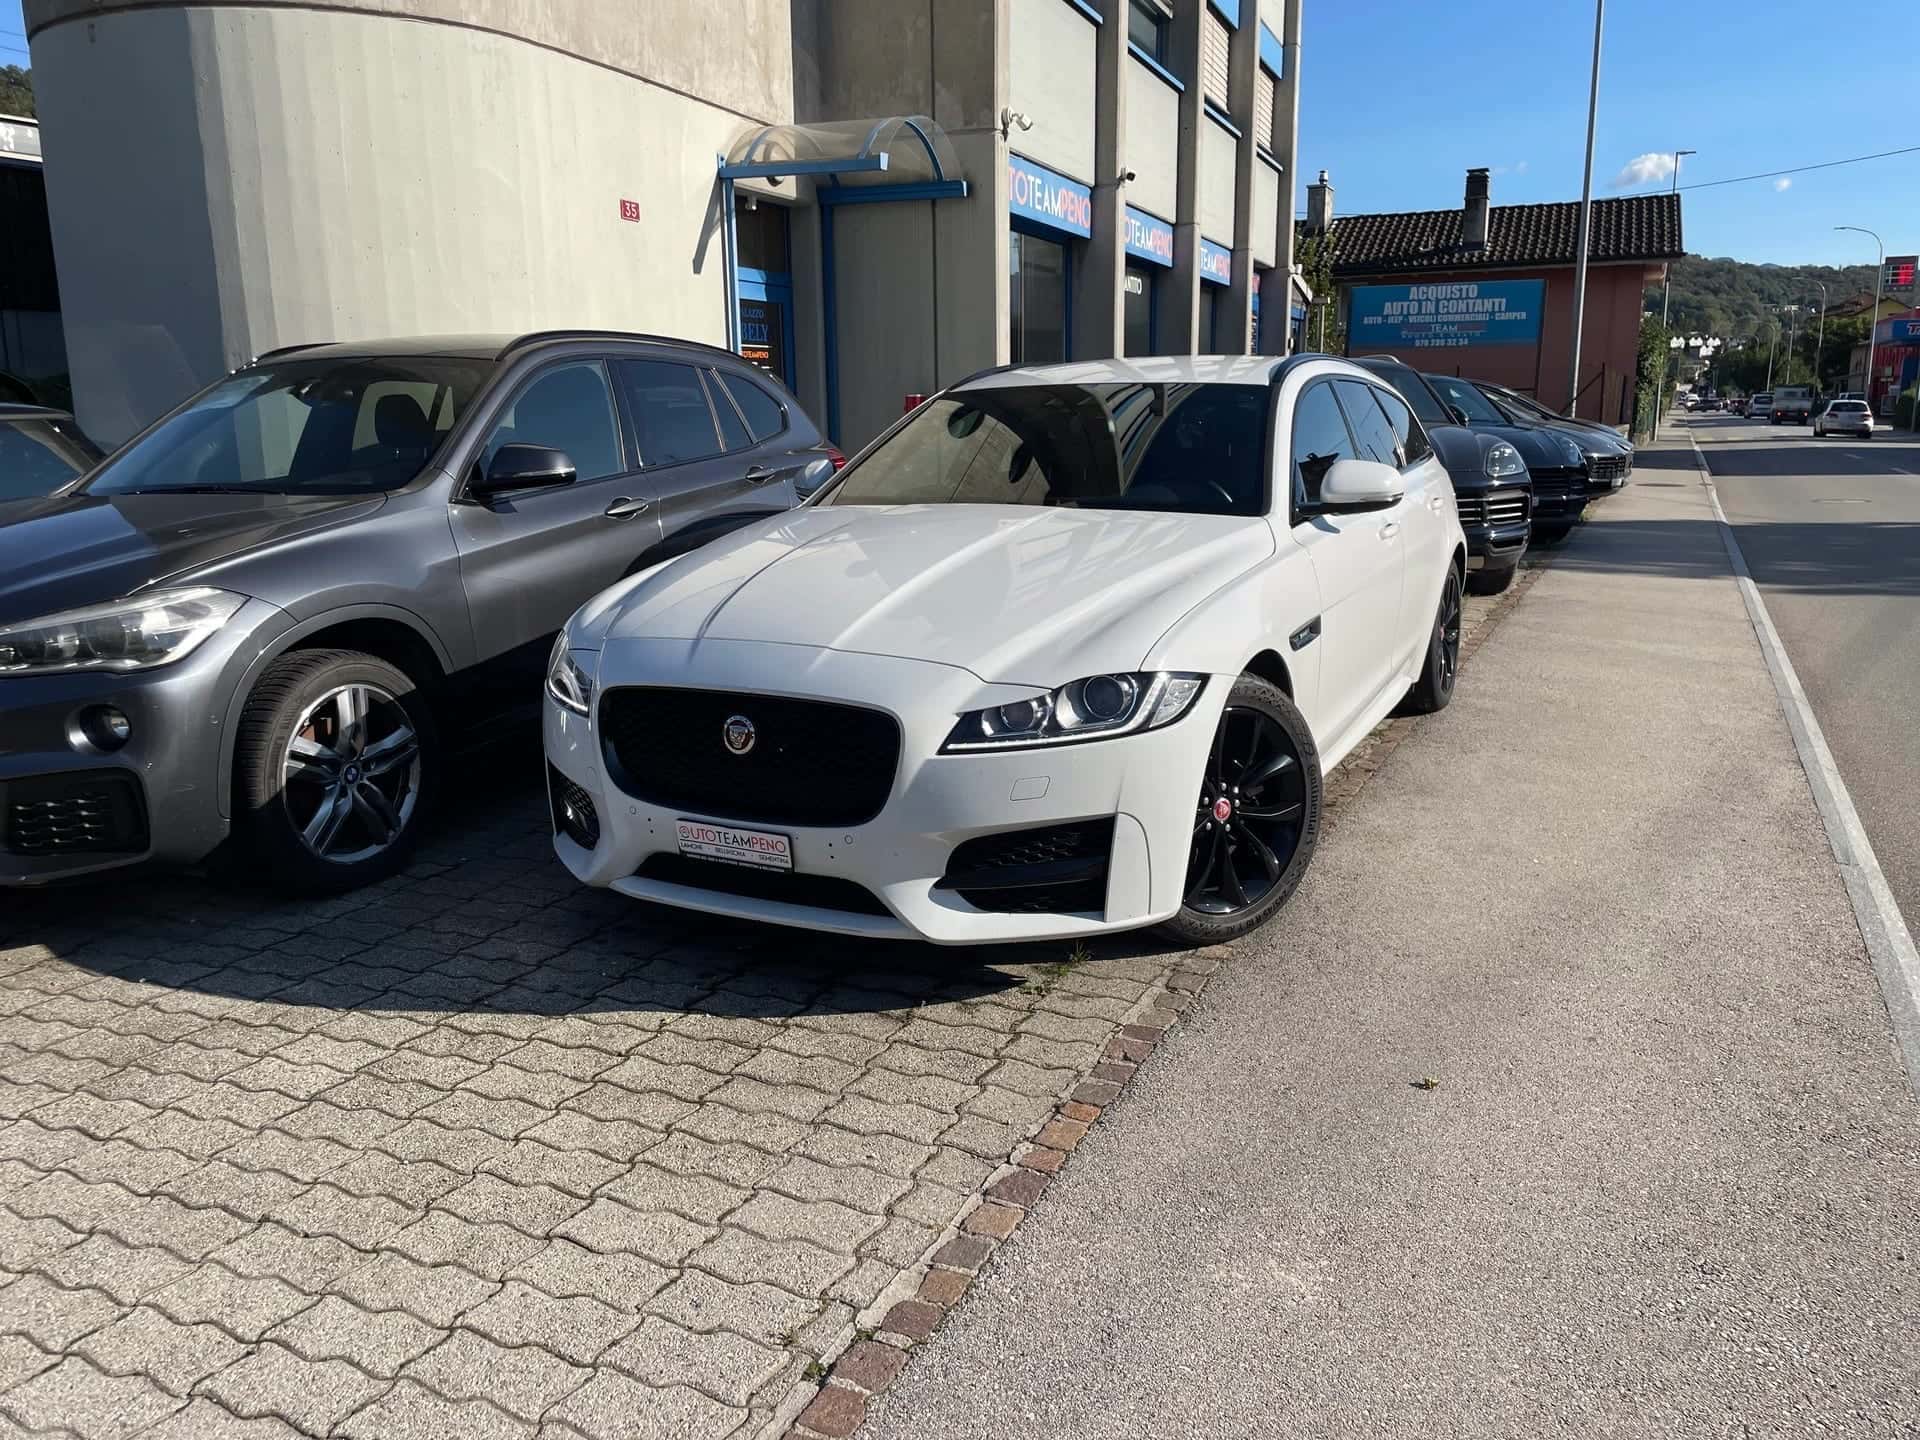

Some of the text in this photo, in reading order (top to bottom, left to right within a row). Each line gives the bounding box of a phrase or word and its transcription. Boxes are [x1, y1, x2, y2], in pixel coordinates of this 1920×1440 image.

[624, 202, 637, 218] 35
[1409, 285, 1478, 300] ACQUISTO
[1383, 298, 1507, 315] AUTO IN CONTANTI
